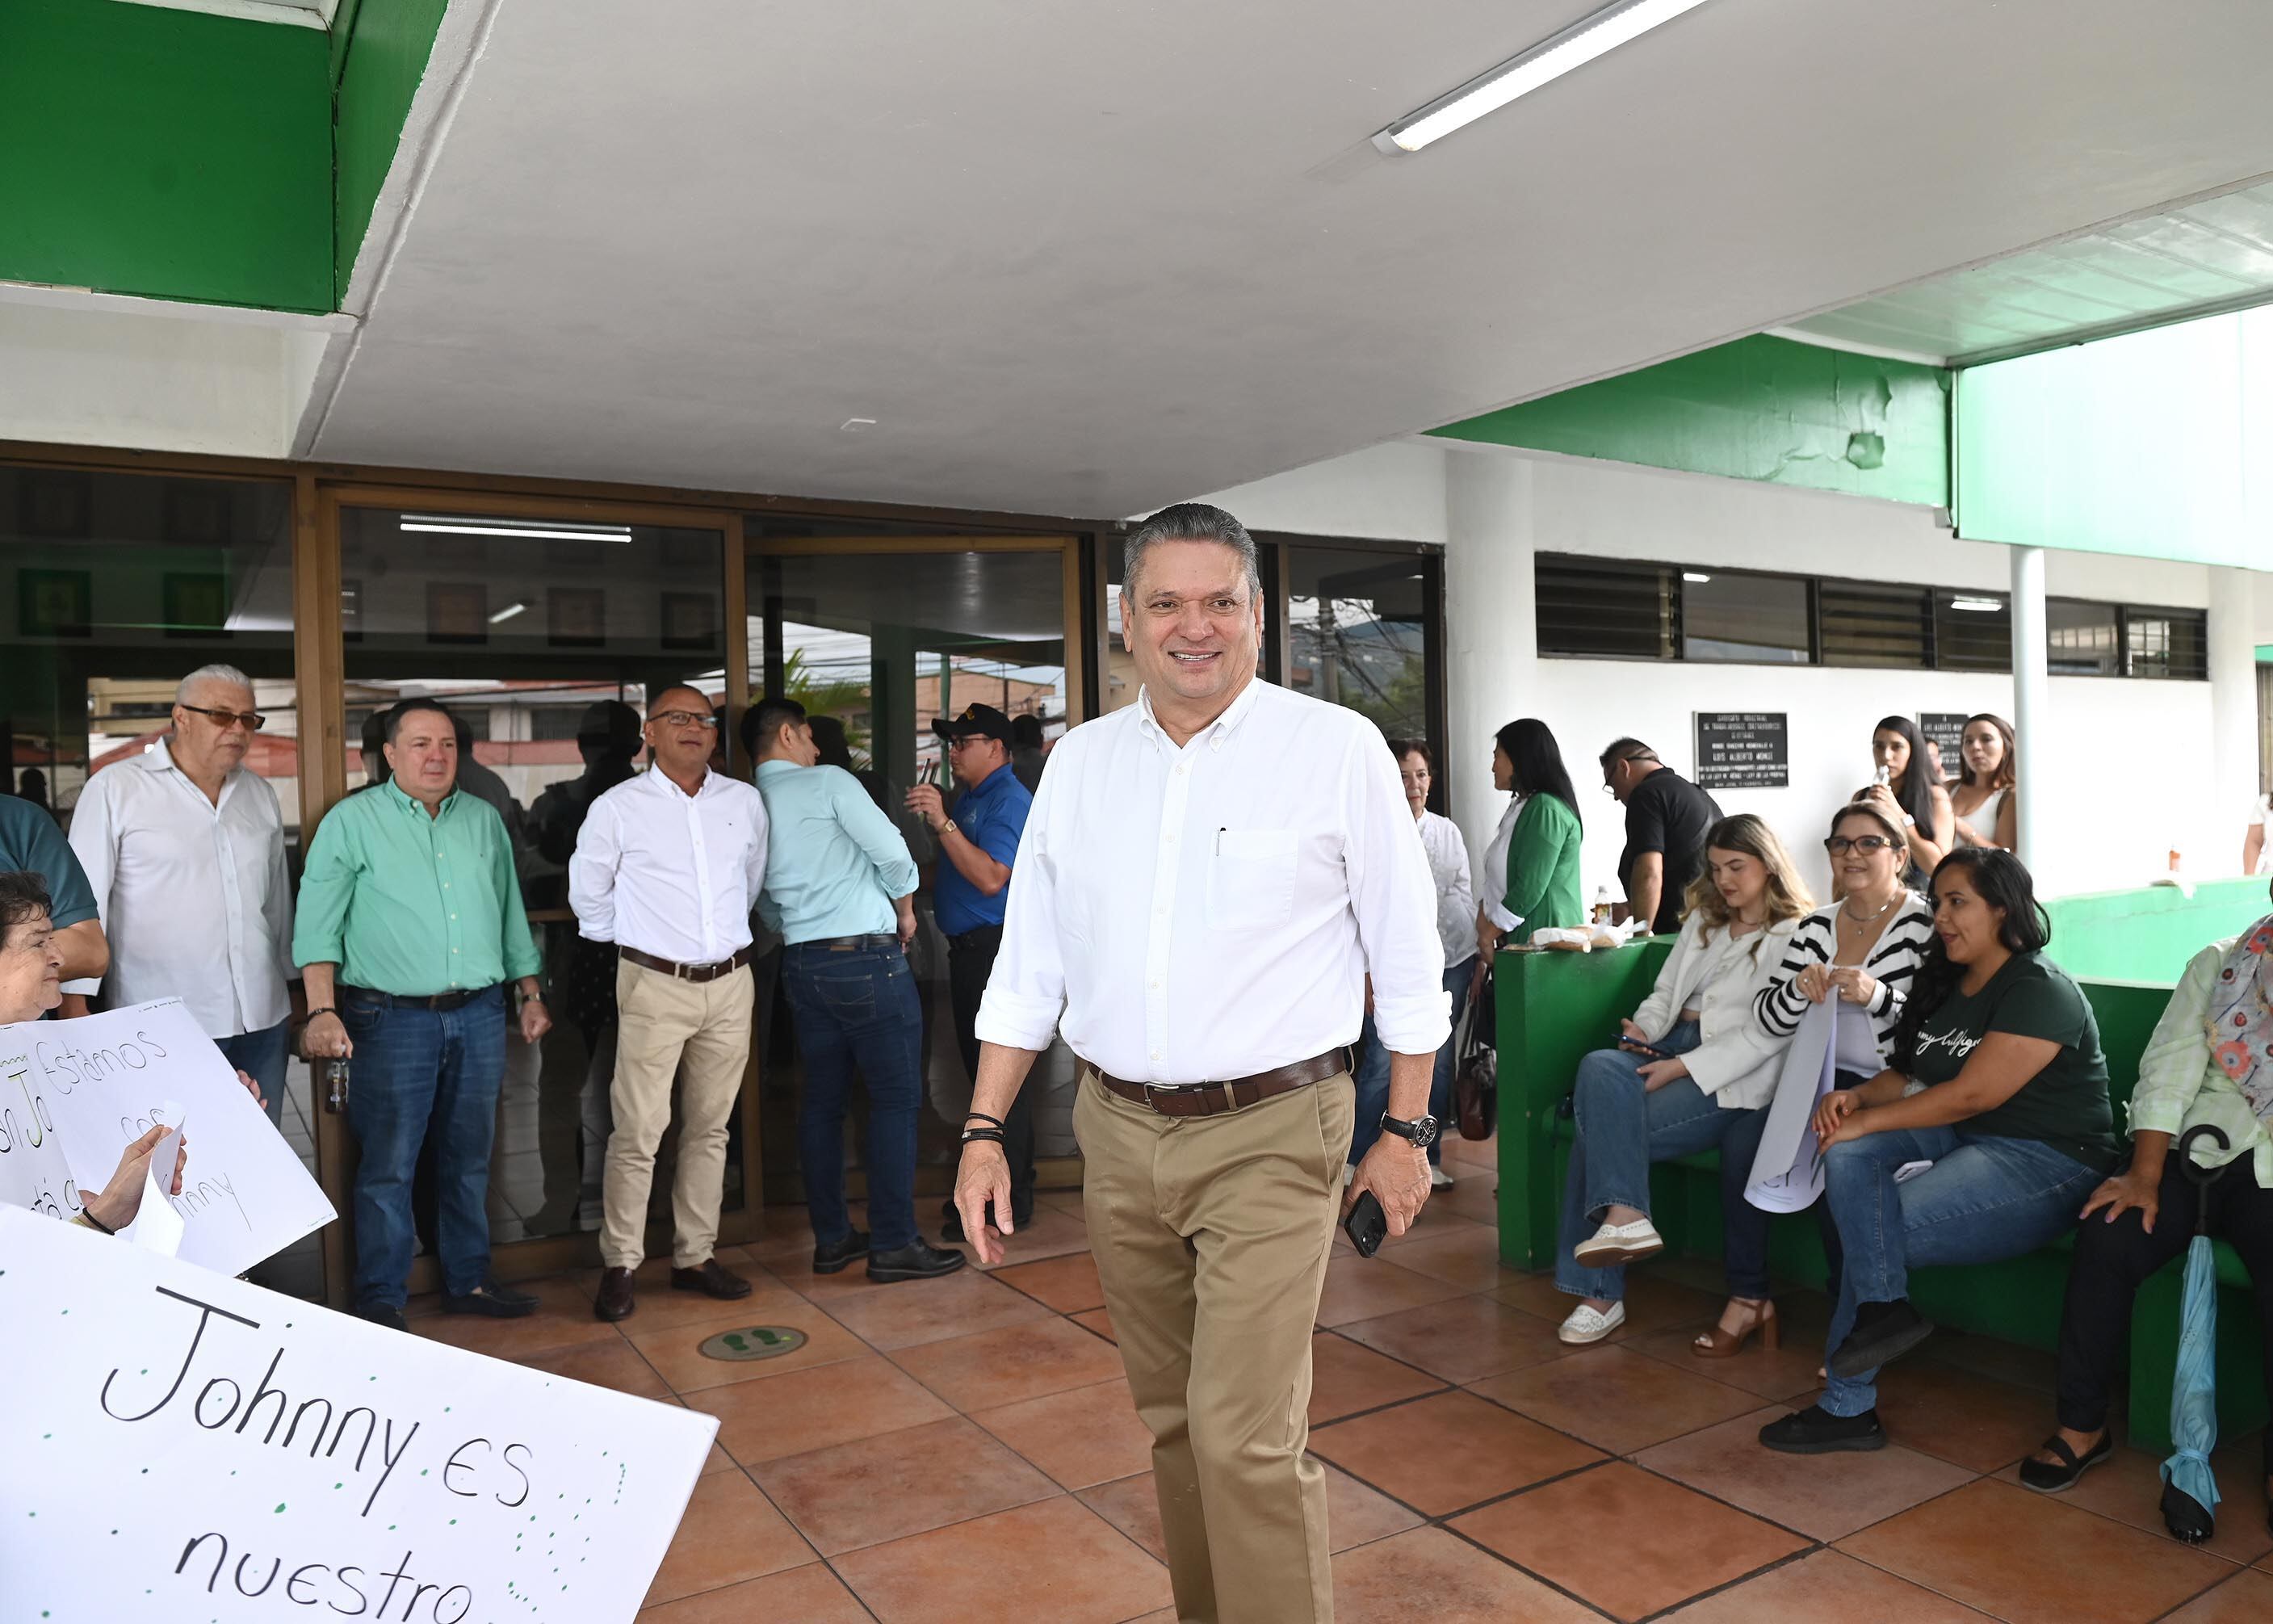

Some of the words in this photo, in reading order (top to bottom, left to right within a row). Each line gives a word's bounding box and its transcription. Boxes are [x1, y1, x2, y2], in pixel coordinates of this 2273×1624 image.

[36, 1030, 167, 1095] Estamos
[101, 1285, 419, 1517] Johnny
[174, 1532, 473, 1624] nuestro
